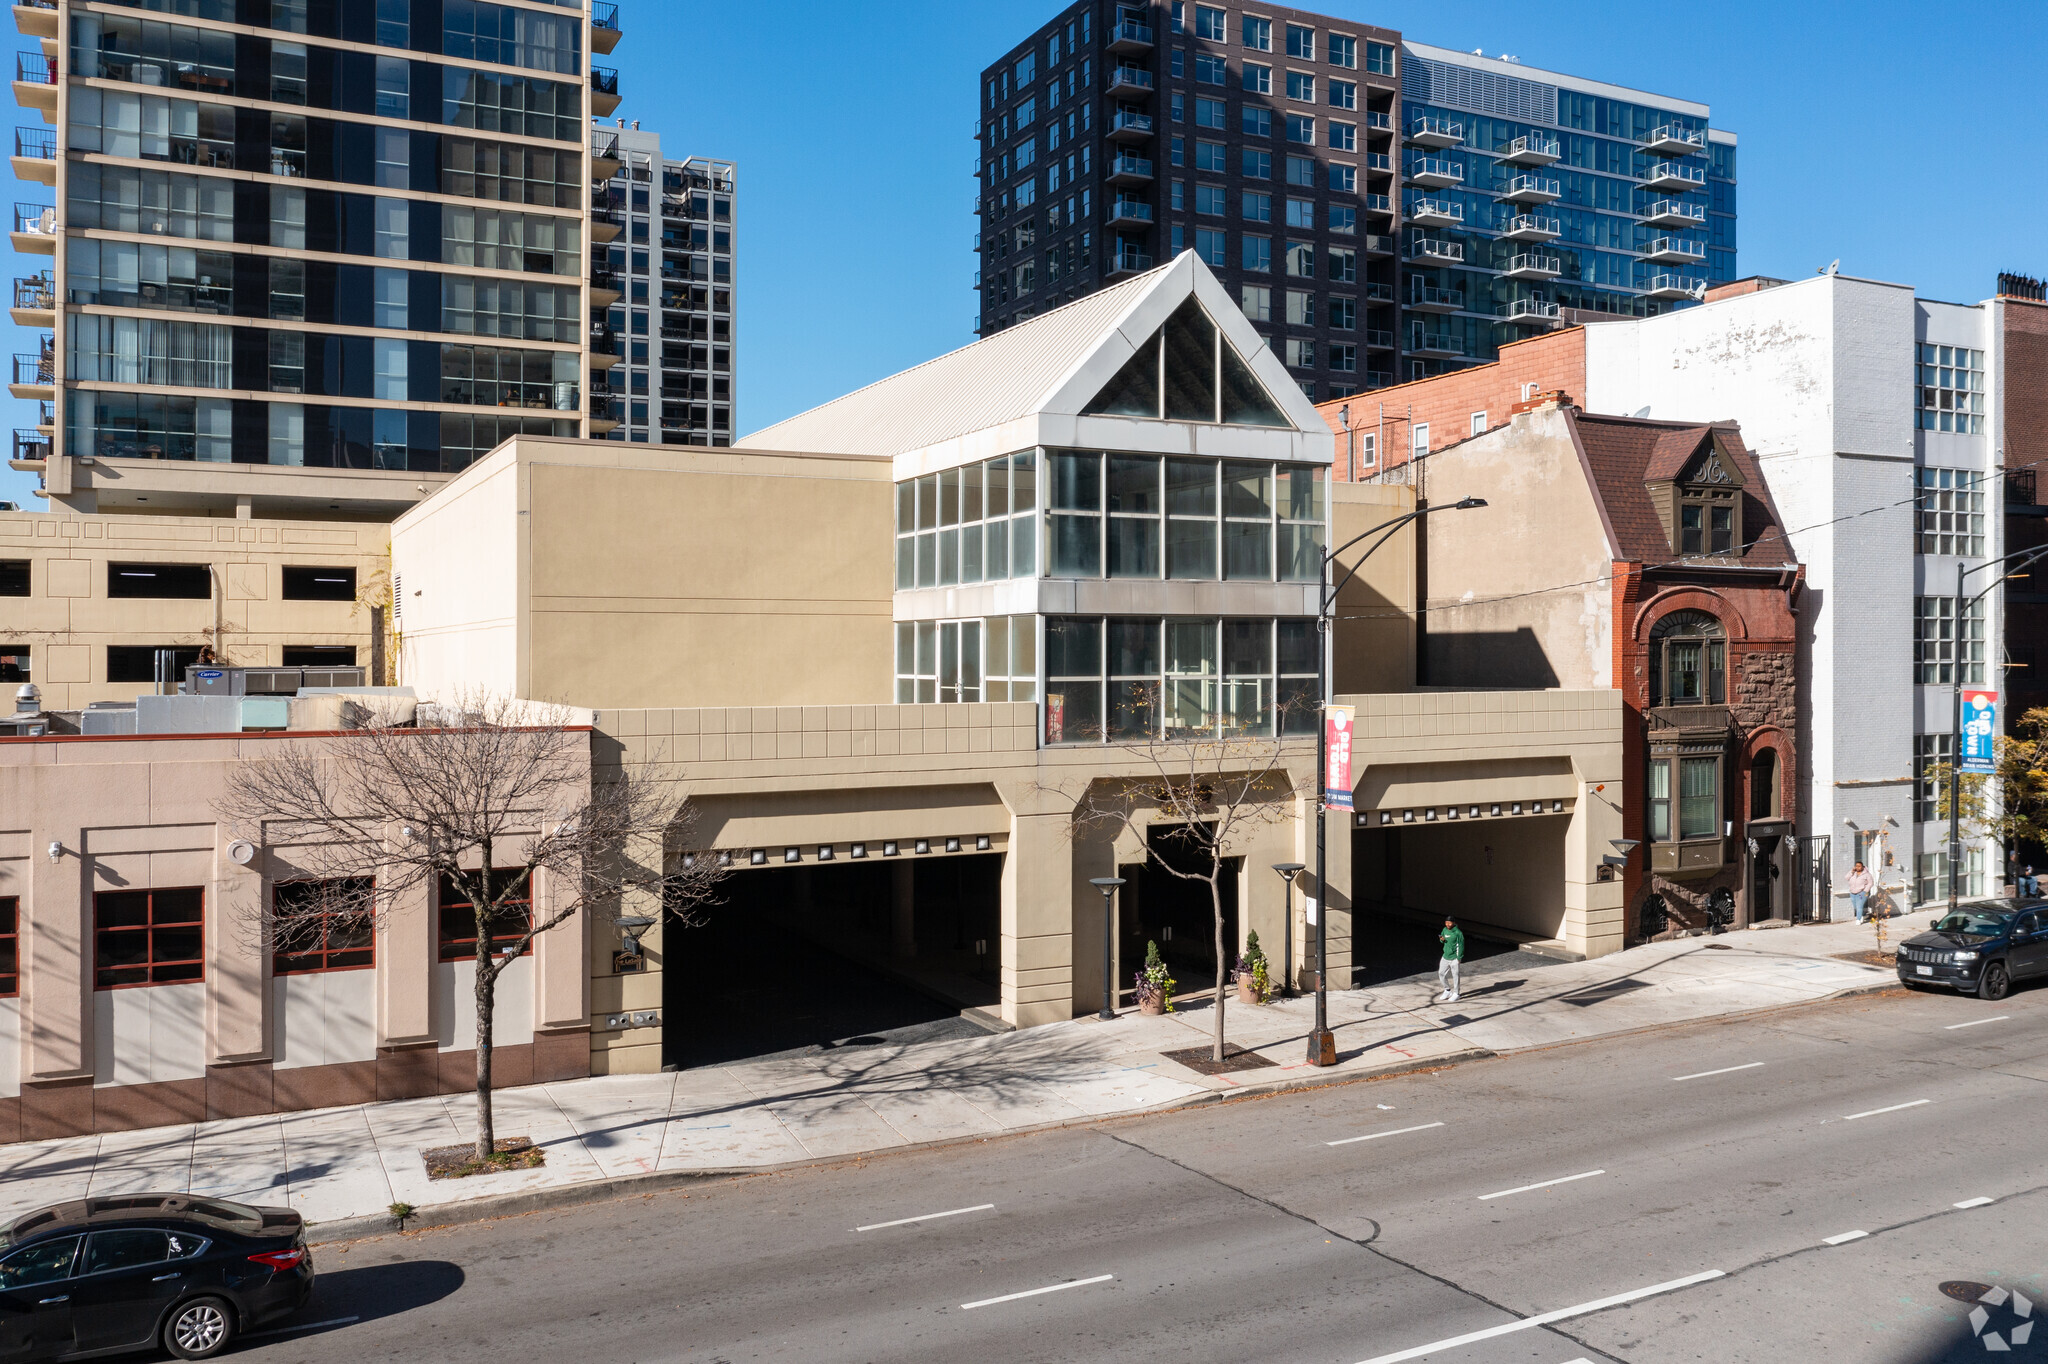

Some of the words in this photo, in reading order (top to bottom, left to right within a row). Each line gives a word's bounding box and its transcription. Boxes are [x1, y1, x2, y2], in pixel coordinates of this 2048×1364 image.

[1966, 718, 1978, 755] TOWN
[1979, 711, 1991, 735] OLD
[1339, 732, 1349, 763] OLD
[1330, 743, 1339, 788] TOWN
[1338, 793, 1352, 801] MARKET
